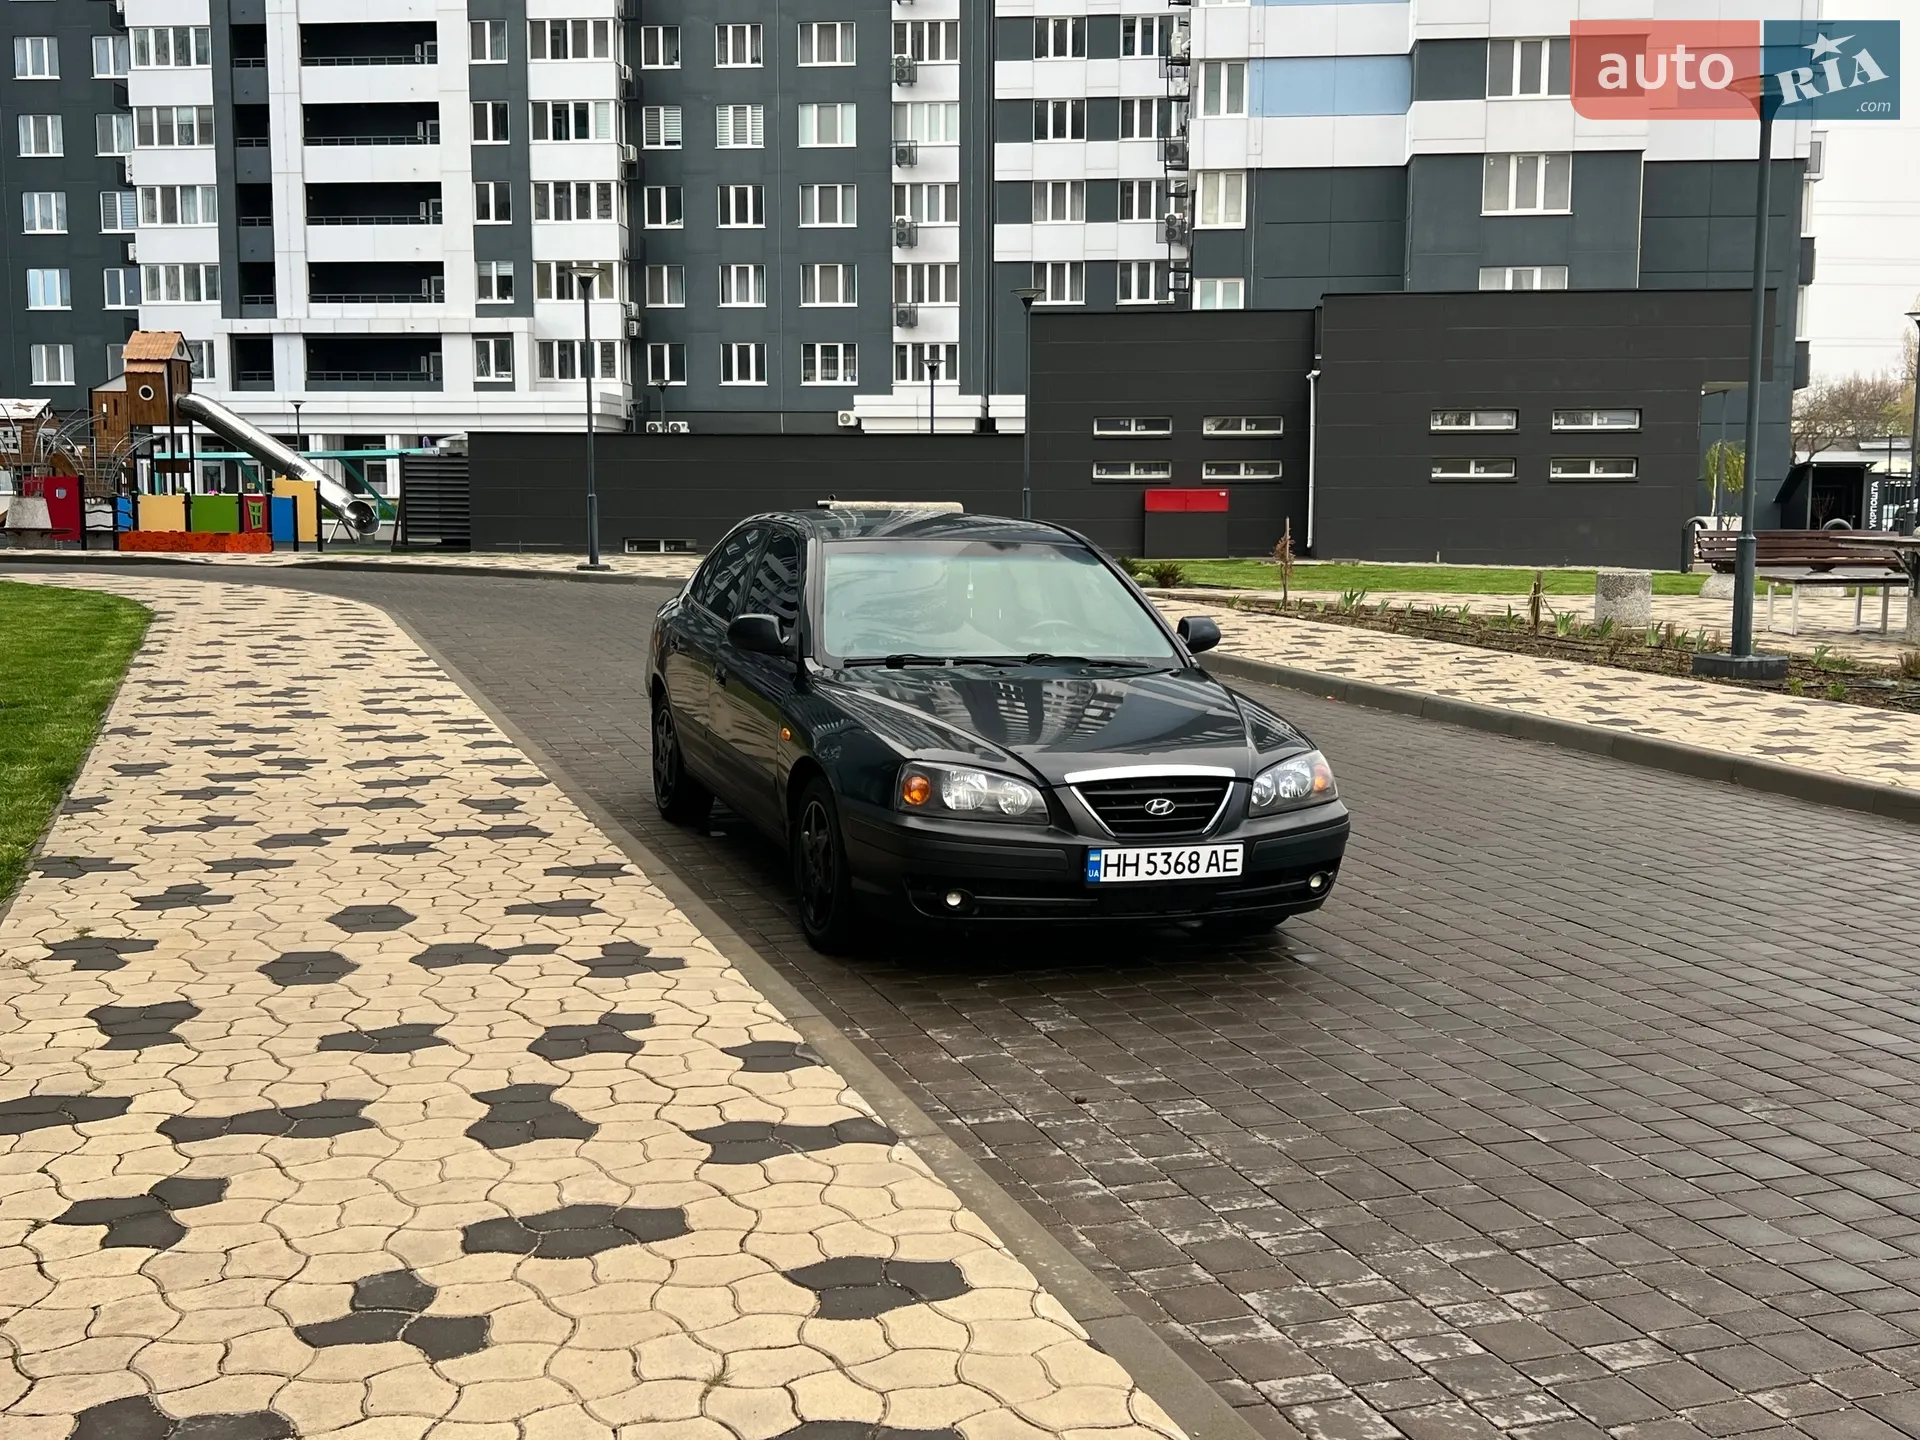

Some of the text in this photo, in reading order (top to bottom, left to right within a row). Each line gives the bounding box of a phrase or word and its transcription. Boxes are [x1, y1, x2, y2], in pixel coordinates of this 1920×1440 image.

[1869, 481, 1879, 529] УКРПОШТА
[1088, 868, 1099, 878] UA
[1103, 849, 1240, 878] HH 5368 AE
